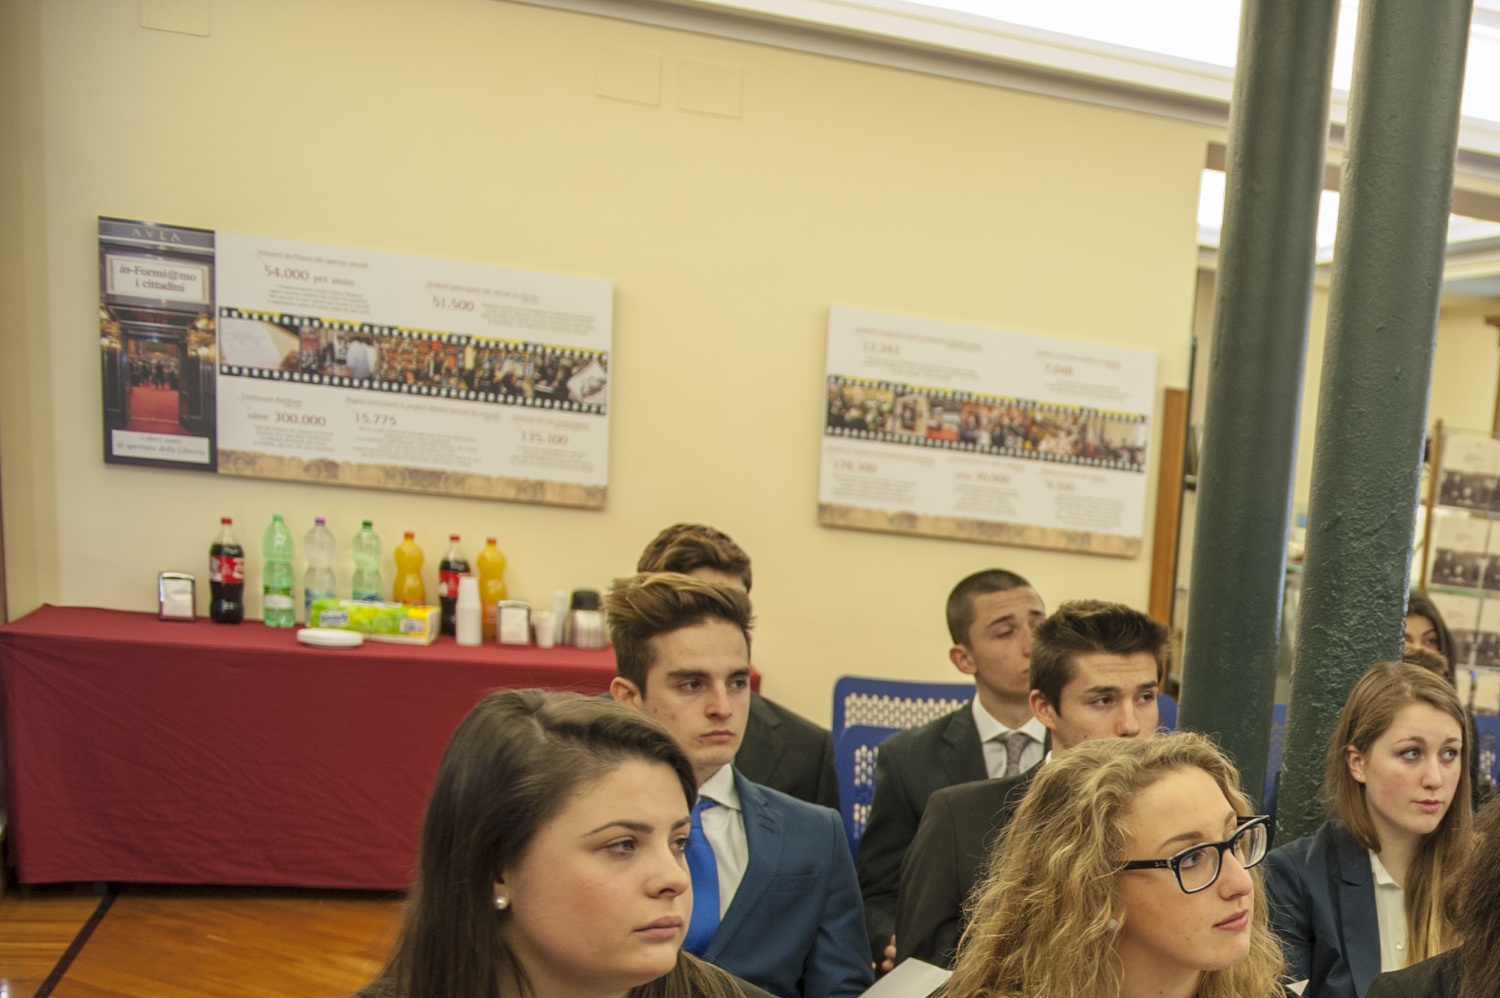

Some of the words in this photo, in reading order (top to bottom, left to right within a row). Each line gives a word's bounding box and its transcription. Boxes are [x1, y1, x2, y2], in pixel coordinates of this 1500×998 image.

[119, 263, 198, 284] in-Formi@mo
[263, 264, 310, 282] 54.000
[142, 278, 186, 293] cittadini
[273, 410, 327, 428] 300.000
